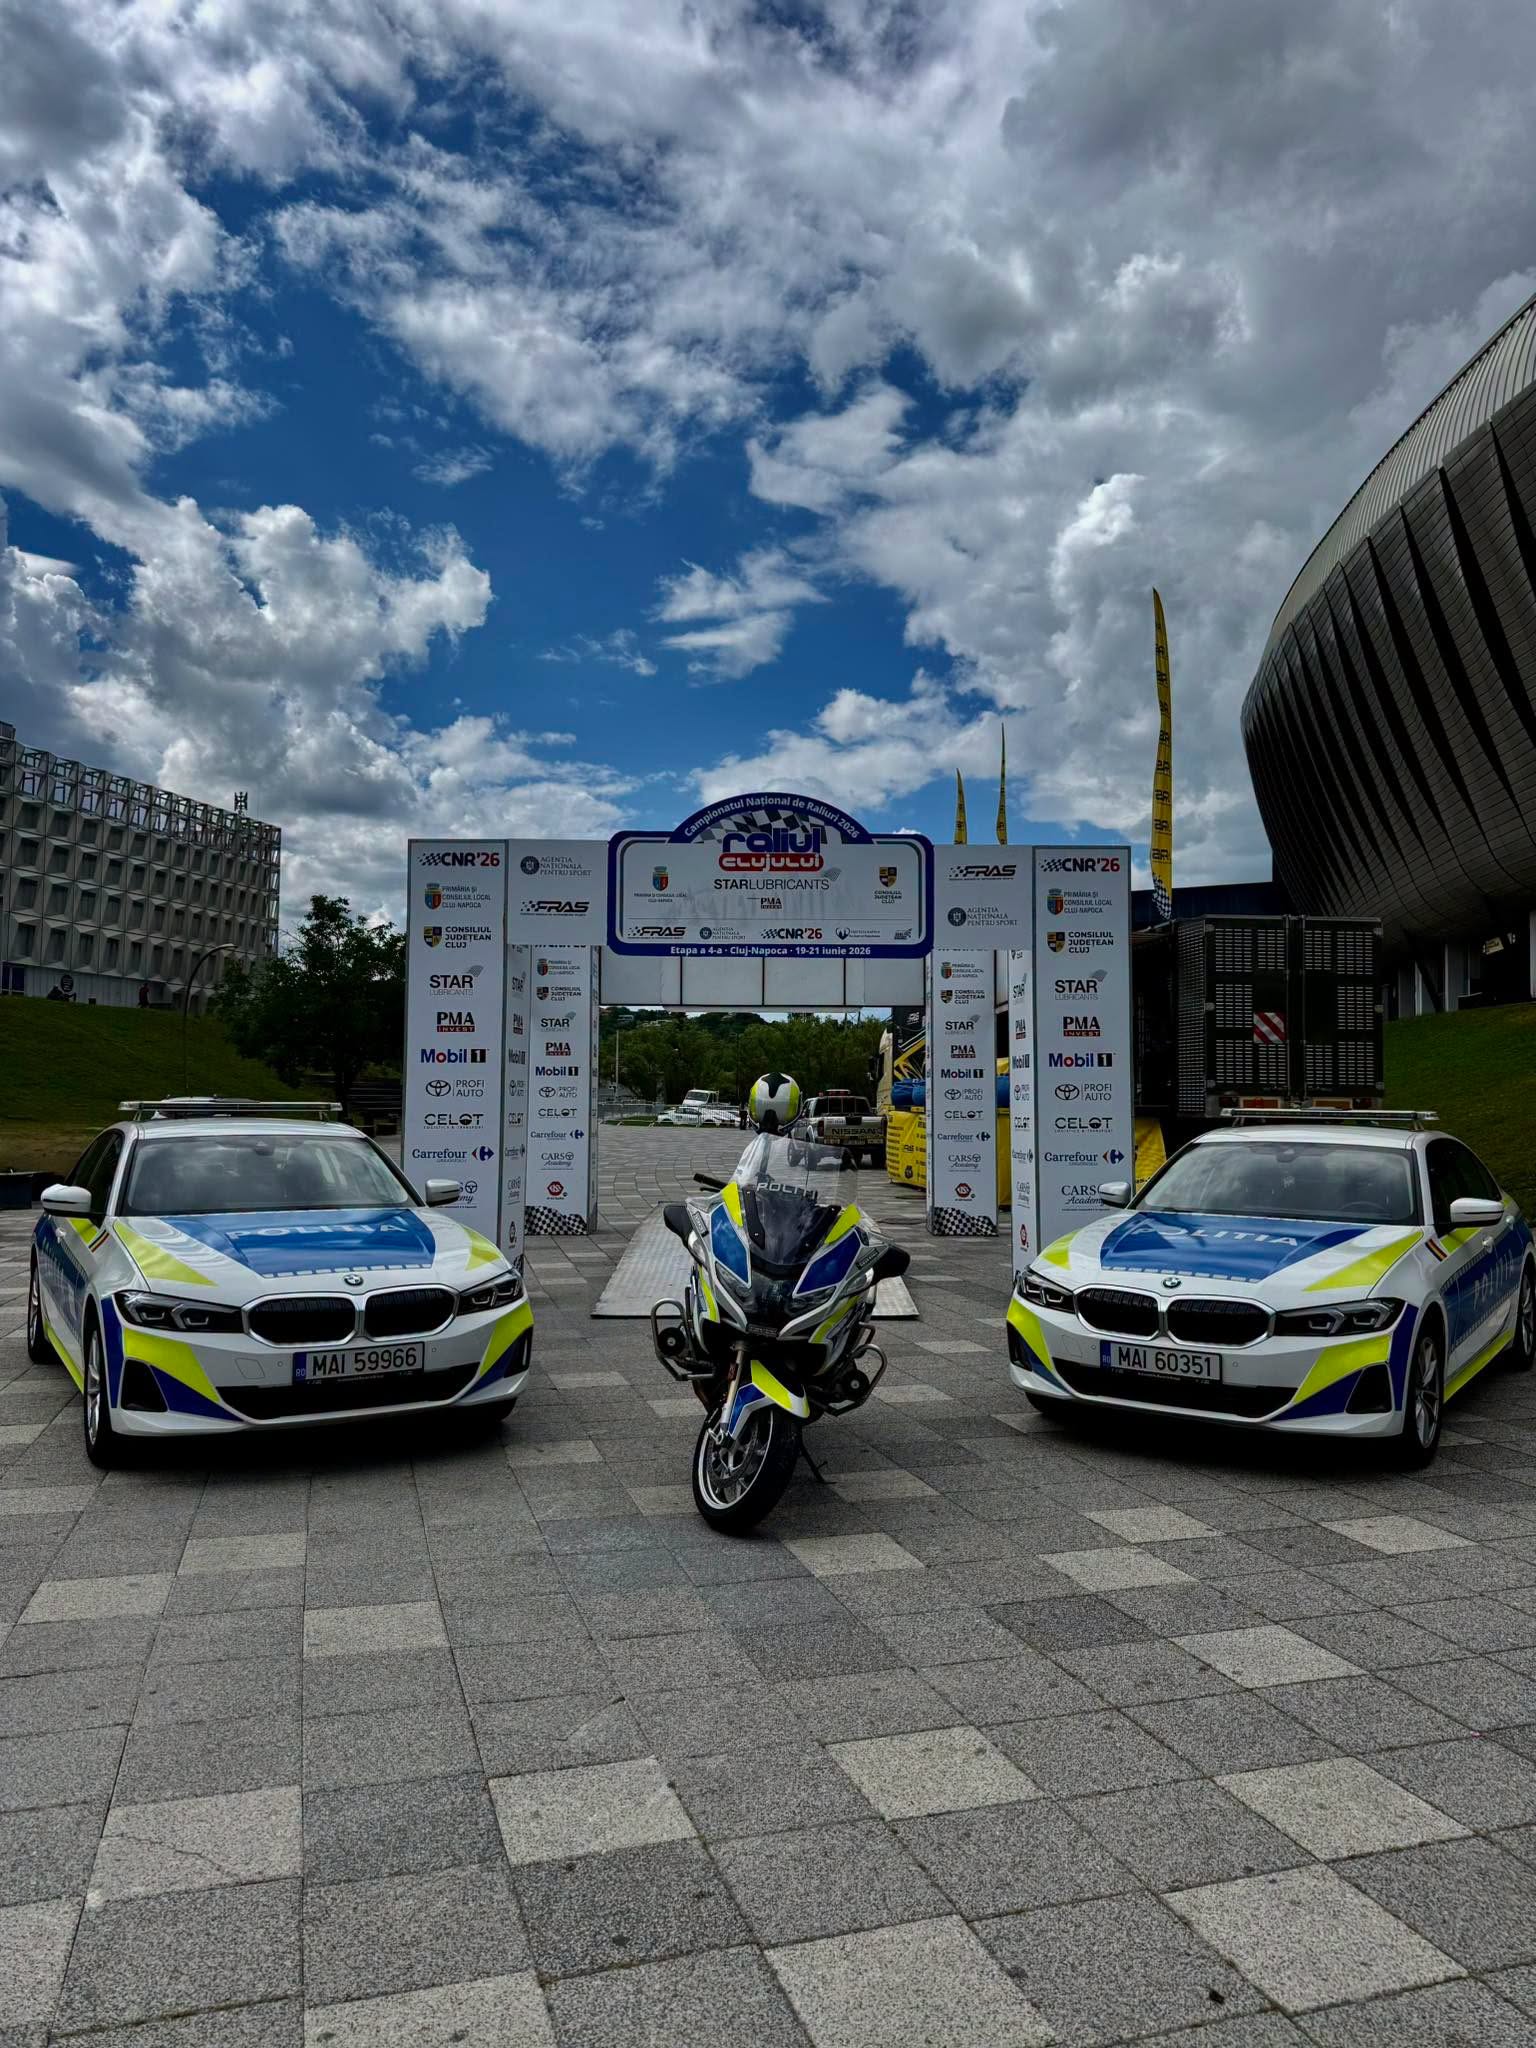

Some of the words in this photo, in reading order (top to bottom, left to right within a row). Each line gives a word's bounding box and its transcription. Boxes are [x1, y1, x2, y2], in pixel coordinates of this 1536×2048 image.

[684, 798, 745, 837] Campionatul
[746, 795, 791, 808] Național
[792, 797, 806, 809] de
[806, 801, 840, 823] Raliuri
[837, 818, 860, 839] 2026
[722, 828, 822, 853] raliul
[441, 852, 500, 867] CNR'26
[1062, 858, 1120, 872] CNR'26
[963, 865, 1016, 877] FRAS
[473, 893, 491, 901] LOCAL
[760, 897, 782, 905] PMA
[535, 901, 590, 912] FRAS
[640, 926, 687, 937] FRAS
[778, 927, 823, 940] CNR'26
[445, 934, 492, 943] JUDEȚEAN
[1068, 939, 1114, 947] JUDEȚEAN
[670, 946, 697, 957] Etapa
[709, 946, 722, 955] 4-a
[730, 946, 788, 957] Cluj-Napoca
[796, 947, 820, 955] 19-21
[822, 946, 848, 955] iunie
[849, 947, 871, 955] 2026
[429, 975, 474, 989] STAR
[1055, 980, 1098, 993] STAR
[430, 988, 473, 996] LUBRICANTS
[436, 1011, 475, 1025] PMA
[541, 1018, 570, 1028] STAR
[1063, 1016, 1100, 1029] PMA
[945, 1021, 974, 1030] STAR
[545, 1042, 571, 1051] PMA
[951, 1045, 975, 1053] PMA
[421, 1048, 467, 1063] Mobil
[1049, 1052, 1093, 1067] Mobil
[535, 1066, 566, 1076] Mobil
[941, 1069, 971, 1078] Mobil
[456, 1080, 484, 1088] PROFI
[1084, 1083, 1112, 1092] PROFI
[457, 1089, 484, 1097] AUTO
[1084, 1092, 1112, 1100] AUTO
[424, 1113, 484, 1126] CELOT
[944, 1110, 983, 1118] CELOT
[1054, 1117, 1113, 1129] CELOT
[412, 1148, 467, 1159] Carrefour
[948, 1154, 972, 1162] CARS
[1044, 1151, 1098, 1162] Carrefour
[1061, 1185, 1097, 1196] CARS
[312, 1353, 346, 1376] MAI
[354, 1347, 417, 1373] 59966
[1118, 1346, 1147, 1369] MAI
[1155, 1351, 1211, 1377] 60351
[295, 1368, 306, 1377] RO
